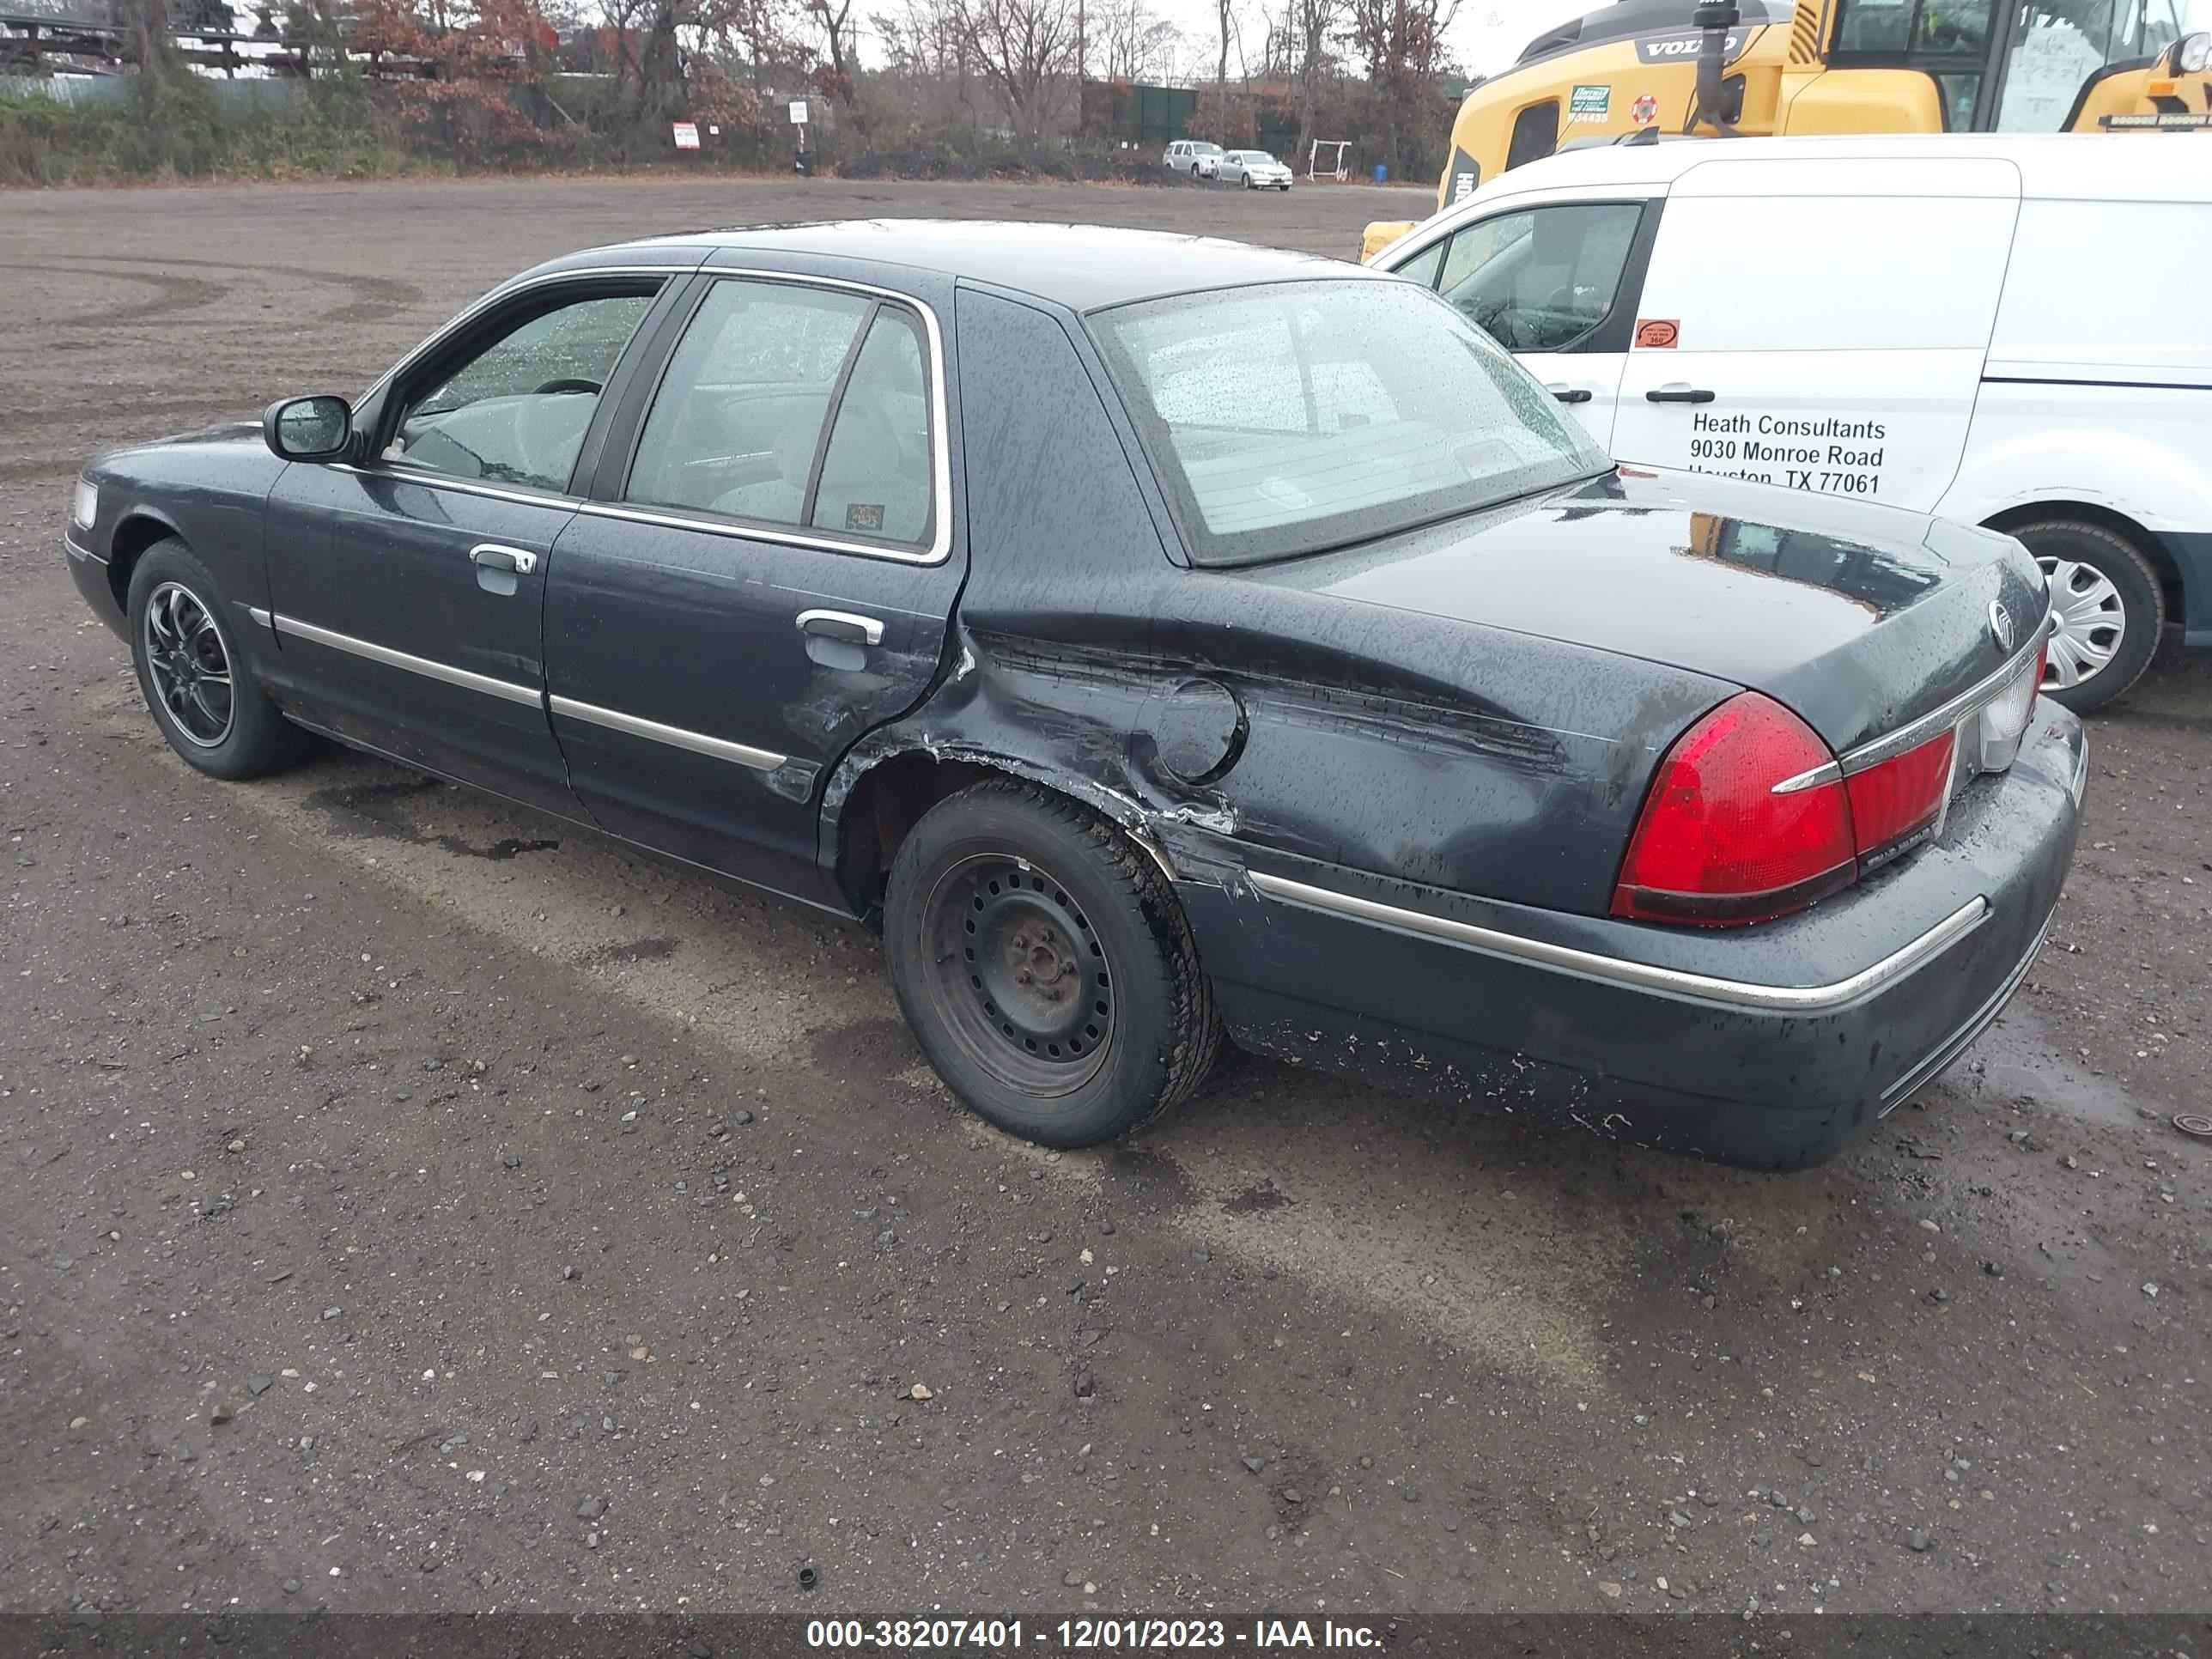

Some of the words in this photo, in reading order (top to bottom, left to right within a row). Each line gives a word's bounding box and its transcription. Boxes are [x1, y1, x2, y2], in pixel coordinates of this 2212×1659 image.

[1646, 37, 1737, 56] VOLO
[1693, 412, 1751, 434] Heath
[1759, 415, 1886, 439] Consultants
[1690, 439, 1736, 459] 9030
[1743, 441, 1820, 464] Monroe
[1827, 445, 1884, 467] Road
[1785, 470, 1812, 491] TX
[1820, 471, 1879, 495] 77061
